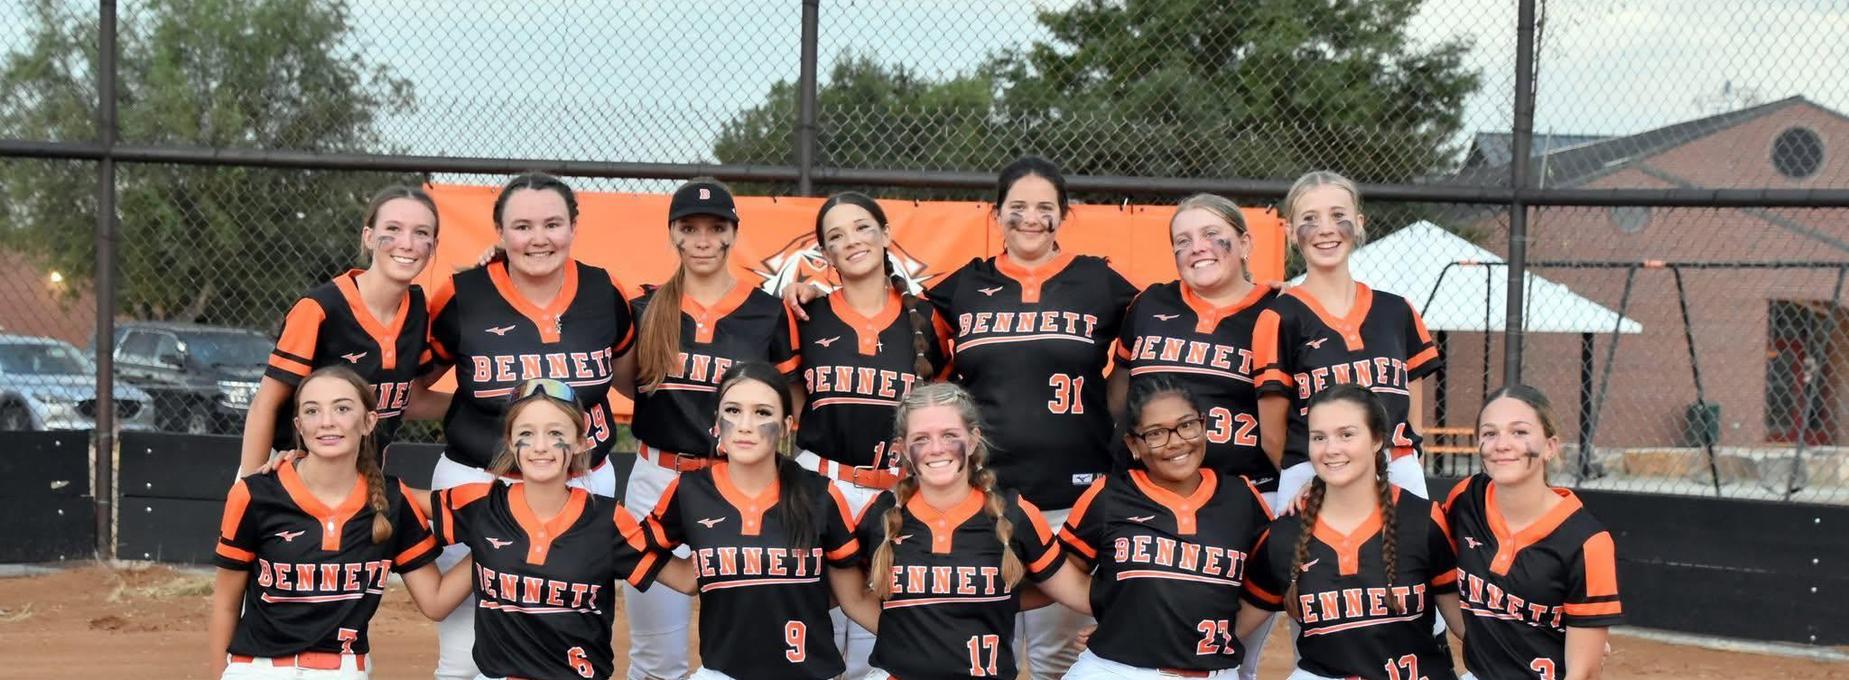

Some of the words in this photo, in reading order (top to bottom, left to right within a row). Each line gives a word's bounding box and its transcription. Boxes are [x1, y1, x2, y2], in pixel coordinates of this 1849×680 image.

[700, 188, 710, 200] B
[959, 312, 1098, 338] BENNETT
[1131, 335, 1254, 375] ENNET
[805, 366, 916, 397] BENNET
[1048, 373, 1084, 414] 31
[582, 403, 610, 451] 29
[1207, 406, 1258, 447] 32
[258, 558, 393, 591] BENNETT
[475, 562, 602, 609] ENNETT
[889, 565, 1011, 595] ENNET
[1300, 583, 1426, 624] ENNETT
[1456, 567, 1565, 629] ENNETT
[337, 627, 359, 655] 7
[784, 620, 807, 663] 9
[967, 634, 999, 677] 17
[567, 646, 595, 679] 6
